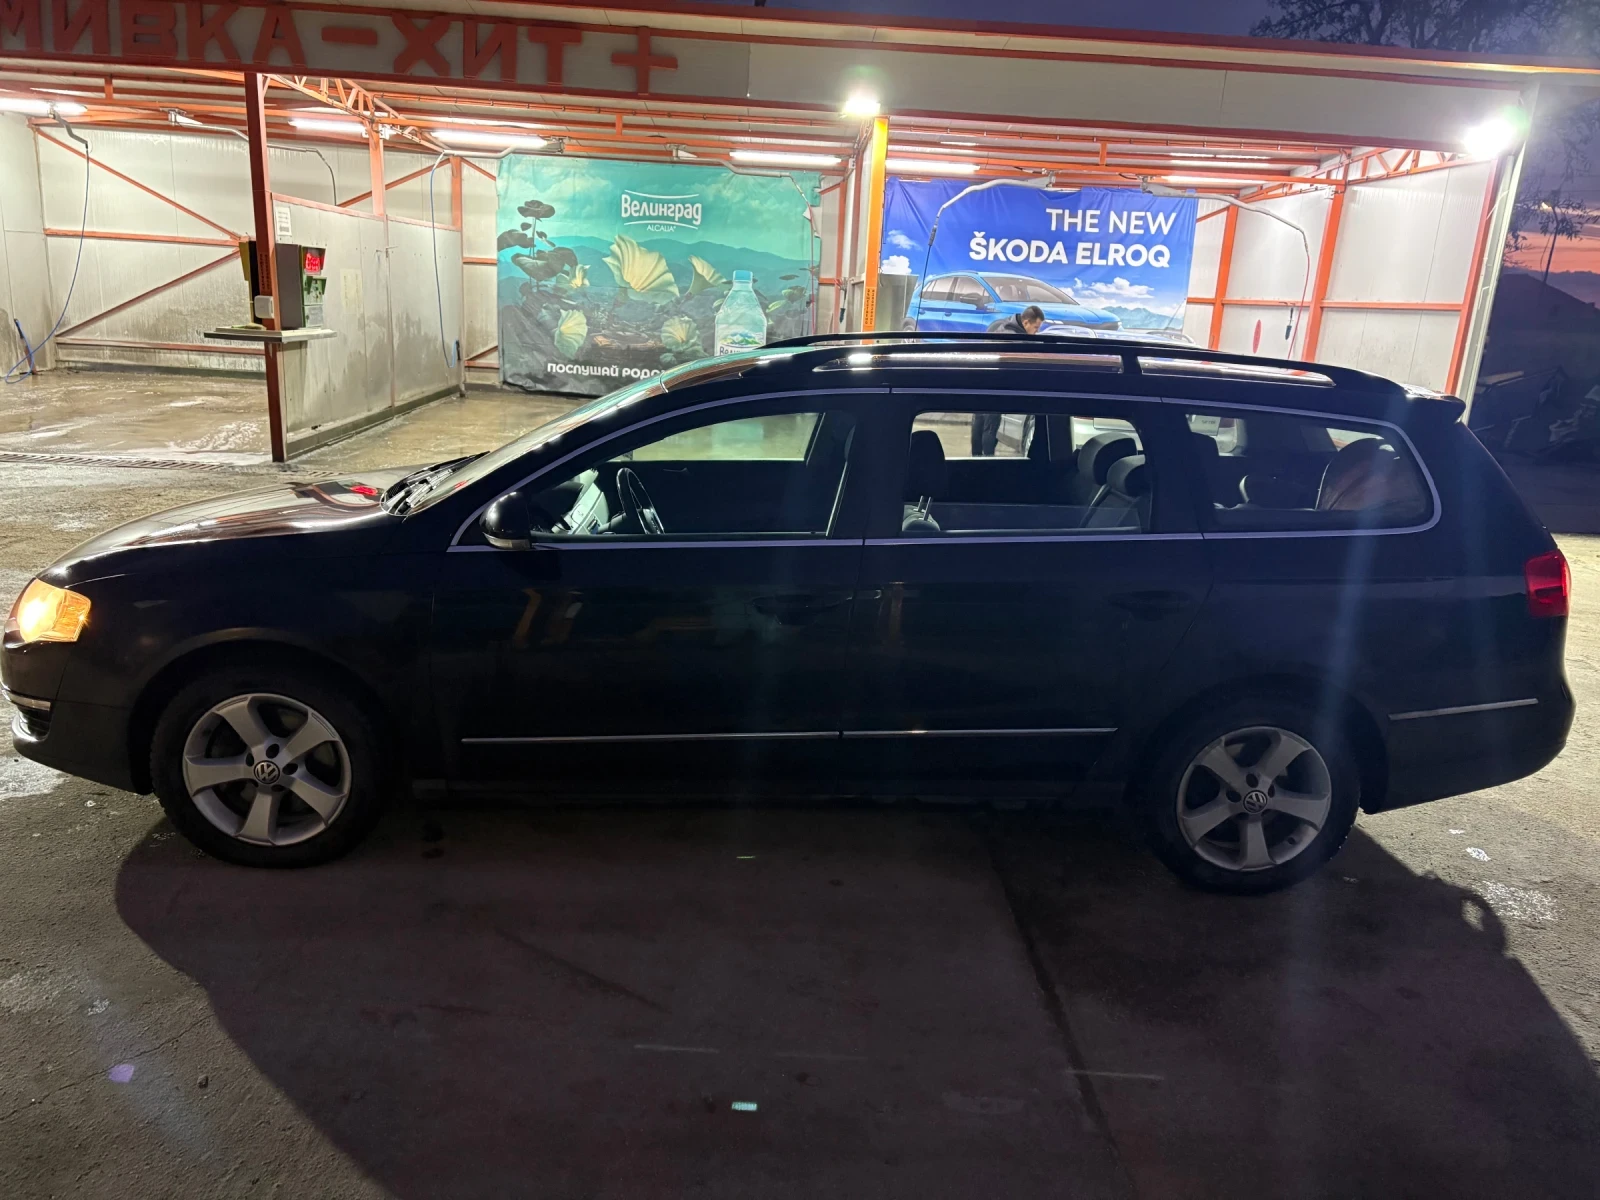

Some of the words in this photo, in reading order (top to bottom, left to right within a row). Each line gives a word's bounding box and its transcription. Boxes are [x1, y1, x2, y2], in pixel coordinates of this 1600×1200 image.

[621, 194, 702, 226] Велинград
[1046, 207, 1100, 233] THE
[1109, 210, 1177, 236] NEW
[969, 231, 1069, 264] ŠKODA
[1076, 242, 1170, 268] ELROQ
